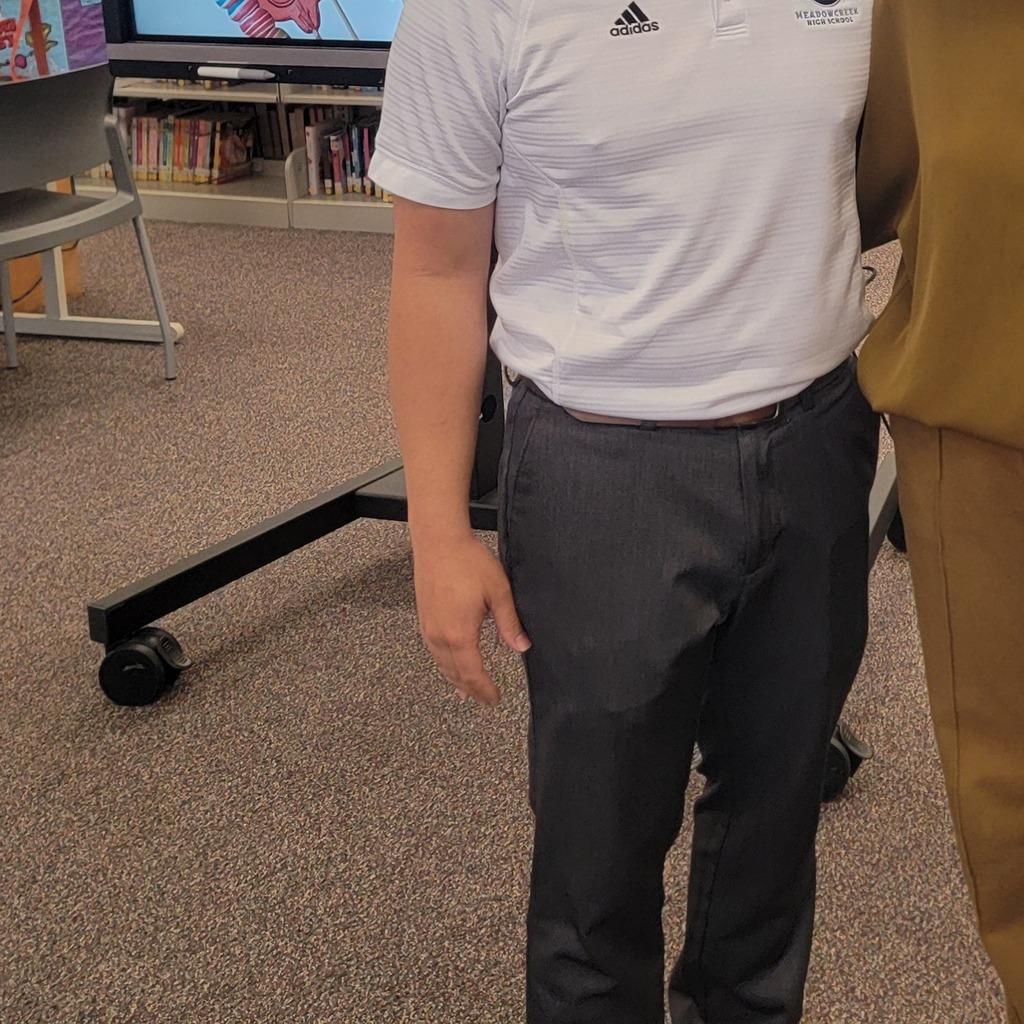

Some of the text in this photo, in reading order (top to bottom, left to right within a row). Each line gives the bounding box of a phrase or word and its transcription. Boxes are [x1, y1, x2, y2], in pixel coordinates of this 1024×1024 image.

[795, 8, 859, 19] MEADOWCREEK
[807, 16, 853, 26] HIGH SCHOOL
[609, 20, 660, 37] adidas
